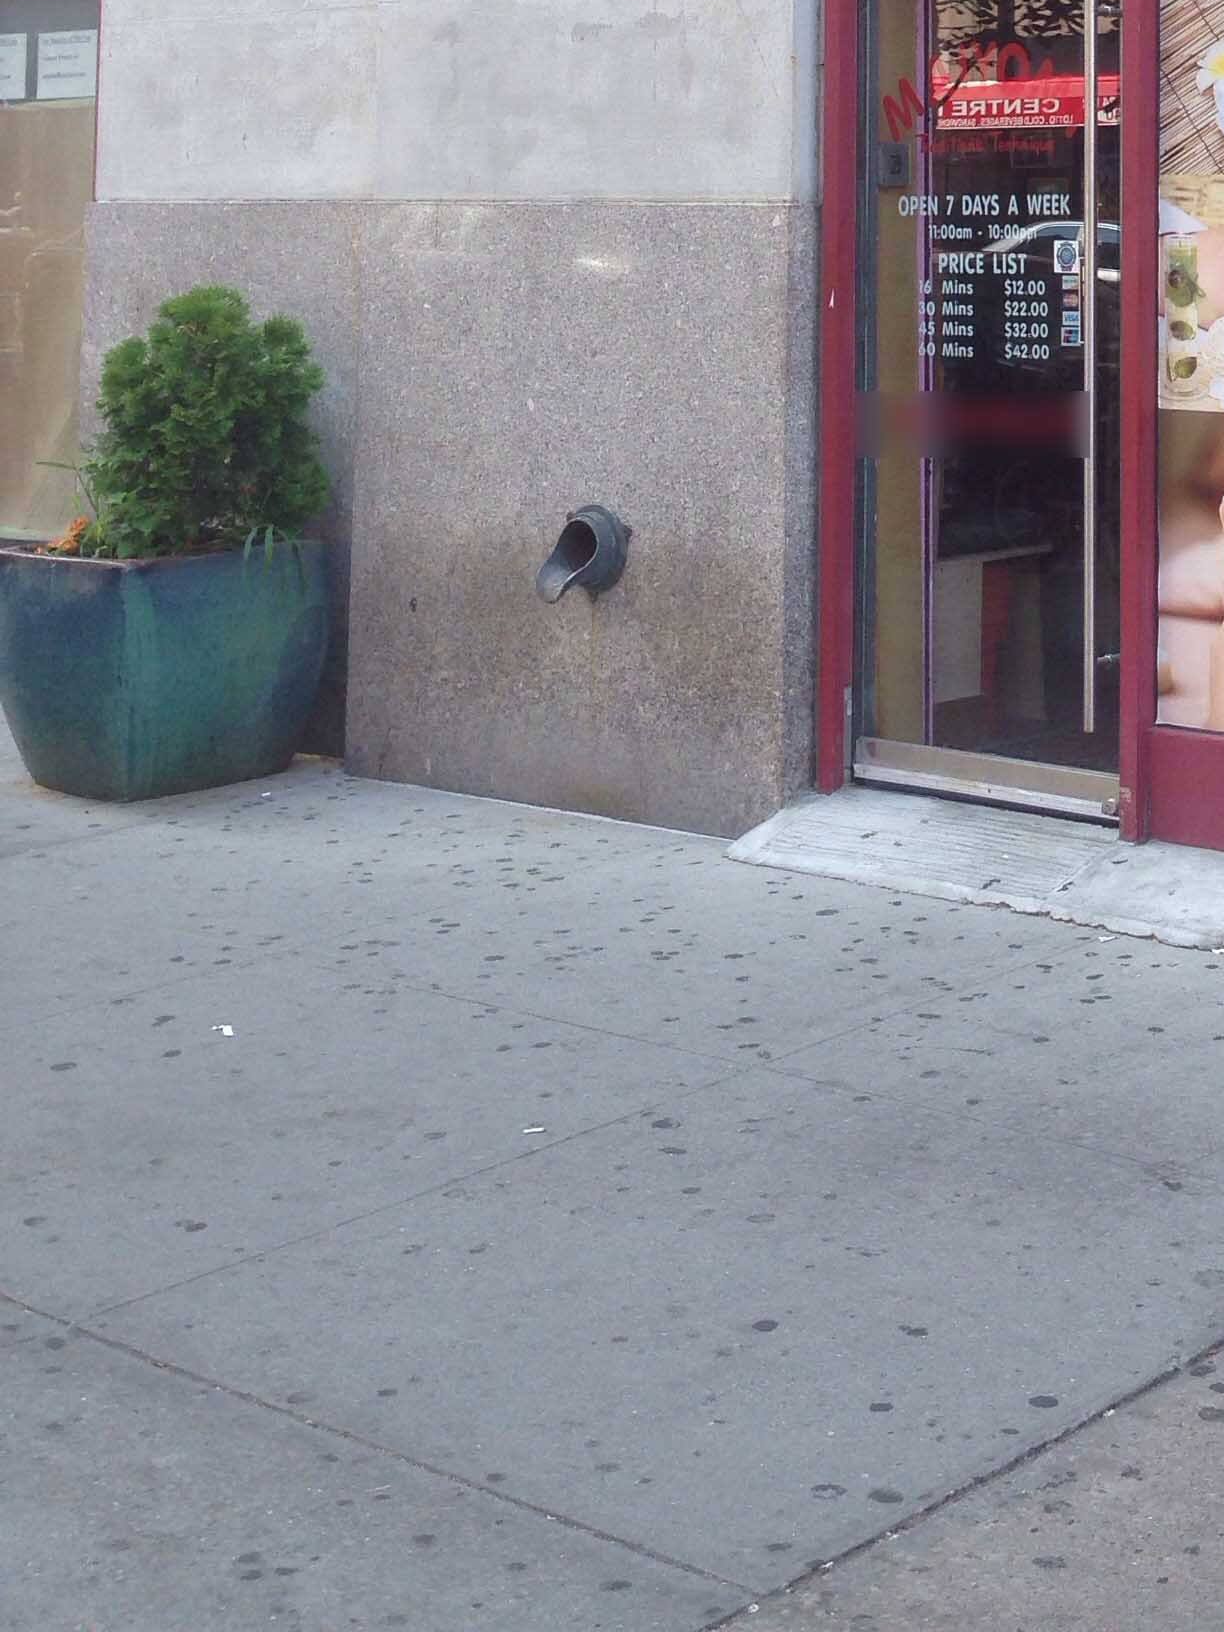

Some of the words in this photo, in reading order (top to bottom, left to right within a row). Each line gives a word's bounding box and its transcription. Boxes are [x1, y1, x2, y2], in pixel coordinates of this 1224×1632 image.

[898, 195, 938, 217] OPEN
[946, 195, 955, 216] 7
[962, 194, 1000, 216] DAYS
[1007, 194, 1019, 216] A
[1027, 193, 1071, 215] WEEK
[928, 224, 973, 239] 11:00am
[938, 253, 985, 274] PRICE
[993, 253, 1028, 274] LIST
[942, 279, 974, 295] Mins
[1004, 279, 1046, 296] $12.00
[919, 301, 936, 317] 30
[942, 301, 974, 317] Mins
[1004, 301, 1049, 318] $22.00
[919, 321, 936, 337] 45
[942, 321, 974, 337] Mins
[1004, 321, 1049, 338] $32.00
[919, 342, 936, 359] 60
[942, 342, 974, 359] Mins
[1004, 342, 1050, 360] $42.00
